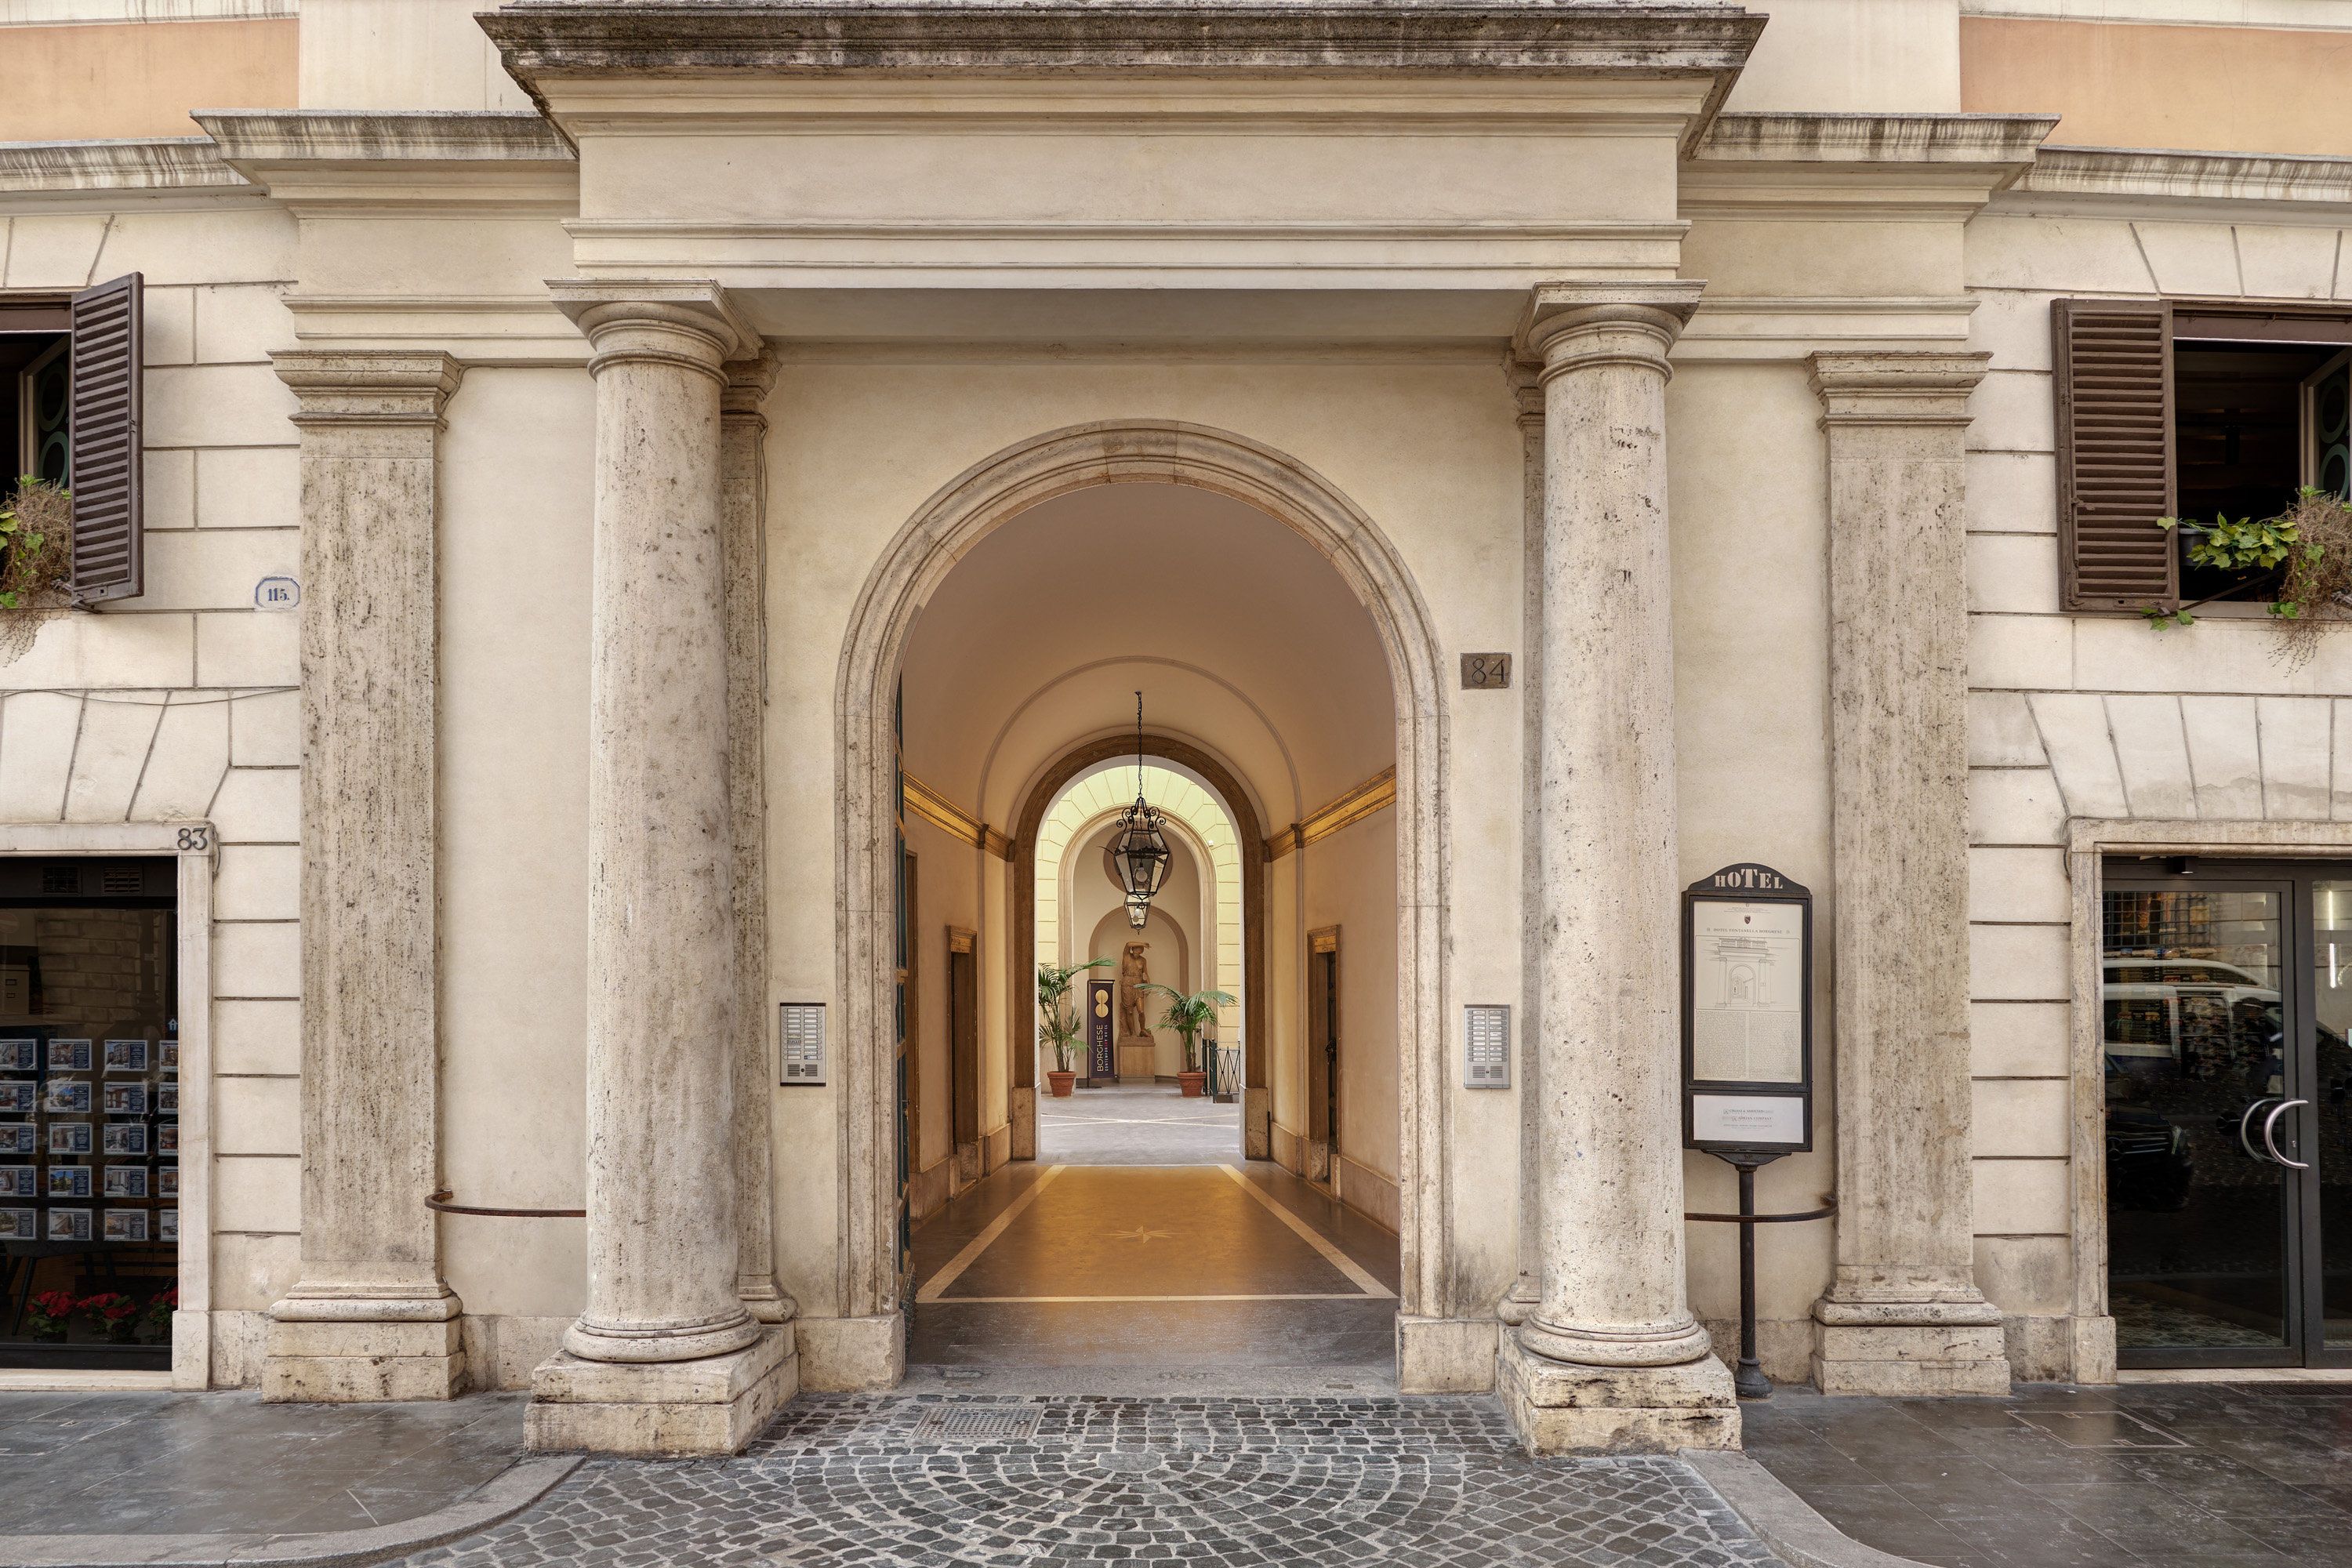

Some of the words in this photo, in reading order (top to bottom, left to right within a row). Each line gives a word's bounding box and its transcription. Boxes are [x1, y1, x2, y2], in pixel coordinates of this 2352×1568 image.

[1472, 658, 1510, 684] 84
[177, 827, 208, 851] 83
[1715, 869, 1784, 889] HOTEL
